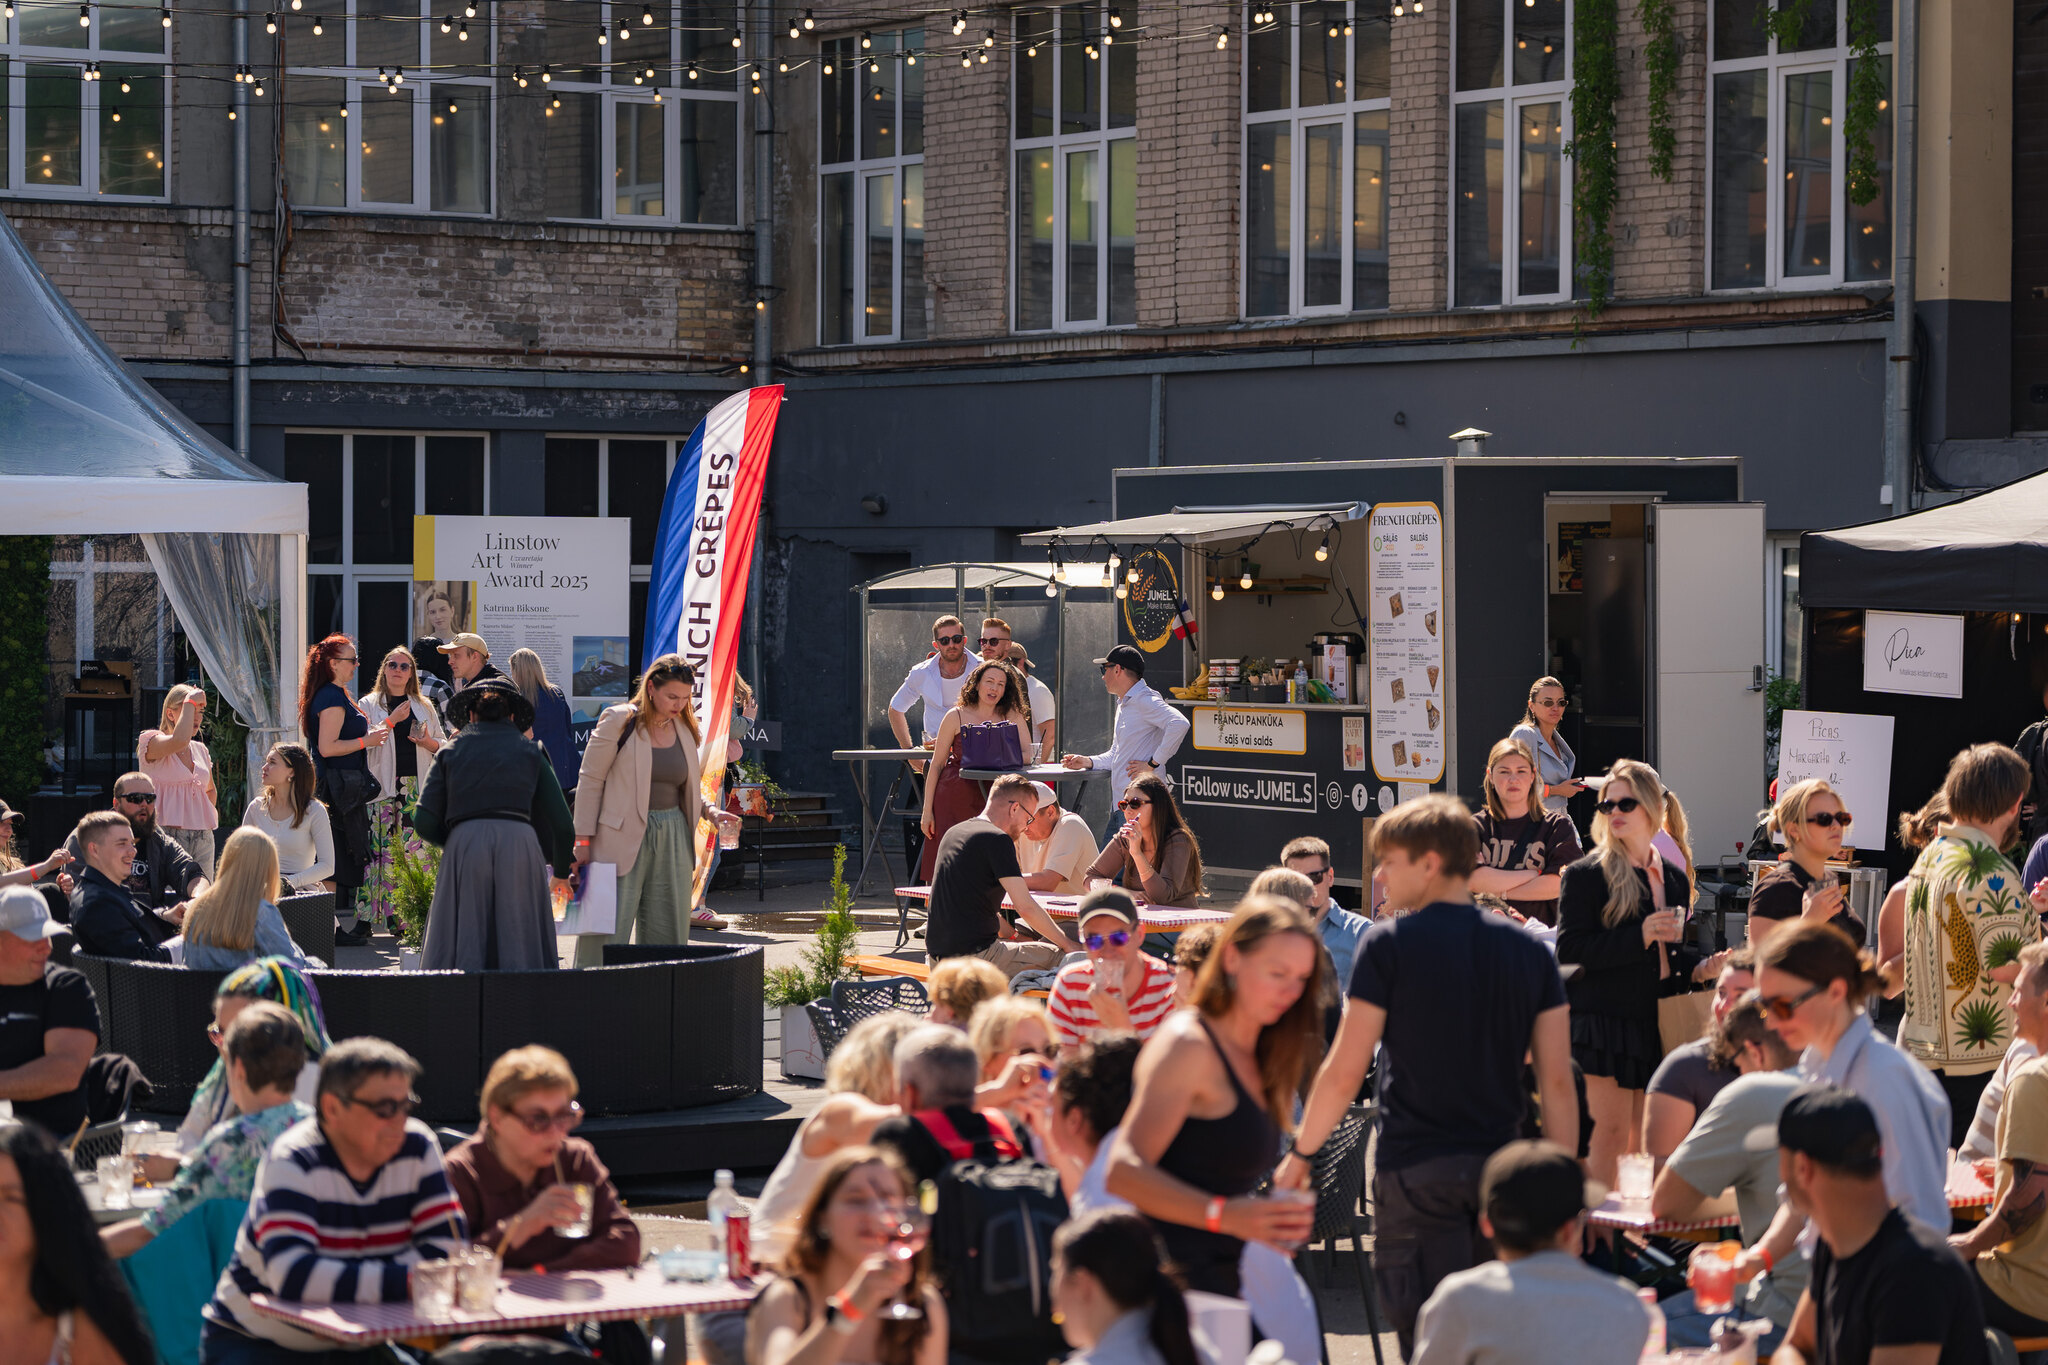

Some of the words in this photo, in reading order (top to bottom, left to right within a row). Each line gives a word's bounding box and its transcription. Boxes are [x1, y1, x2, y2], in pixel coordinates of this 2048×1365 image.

[695, 454, 734, 578] CRÊPES
[1374, 515, 1404, 526] FRENCH
[1406, 512, 1437, 525] CRÊPES
[486, 533, 560, 550] Linstow
[471, 552, 503, 568] Art
[484, 571, 544, 588] Award
[550, 575, 588, 592] 2025
[516, 604, 550, 613] Biksone
[1884, 627, 1925, 672] Pica
[1246, 714, 1284, 727] PANKŪKA
[1224, 734, 1238, 747] sāļš
[1240, 734, 1252, 745] vai
[1253, 735, 1273, 746] salds
[1188, 776, 1230, 797] Follow
[1233, 780, 1312, 804] us-JUMEL.S
